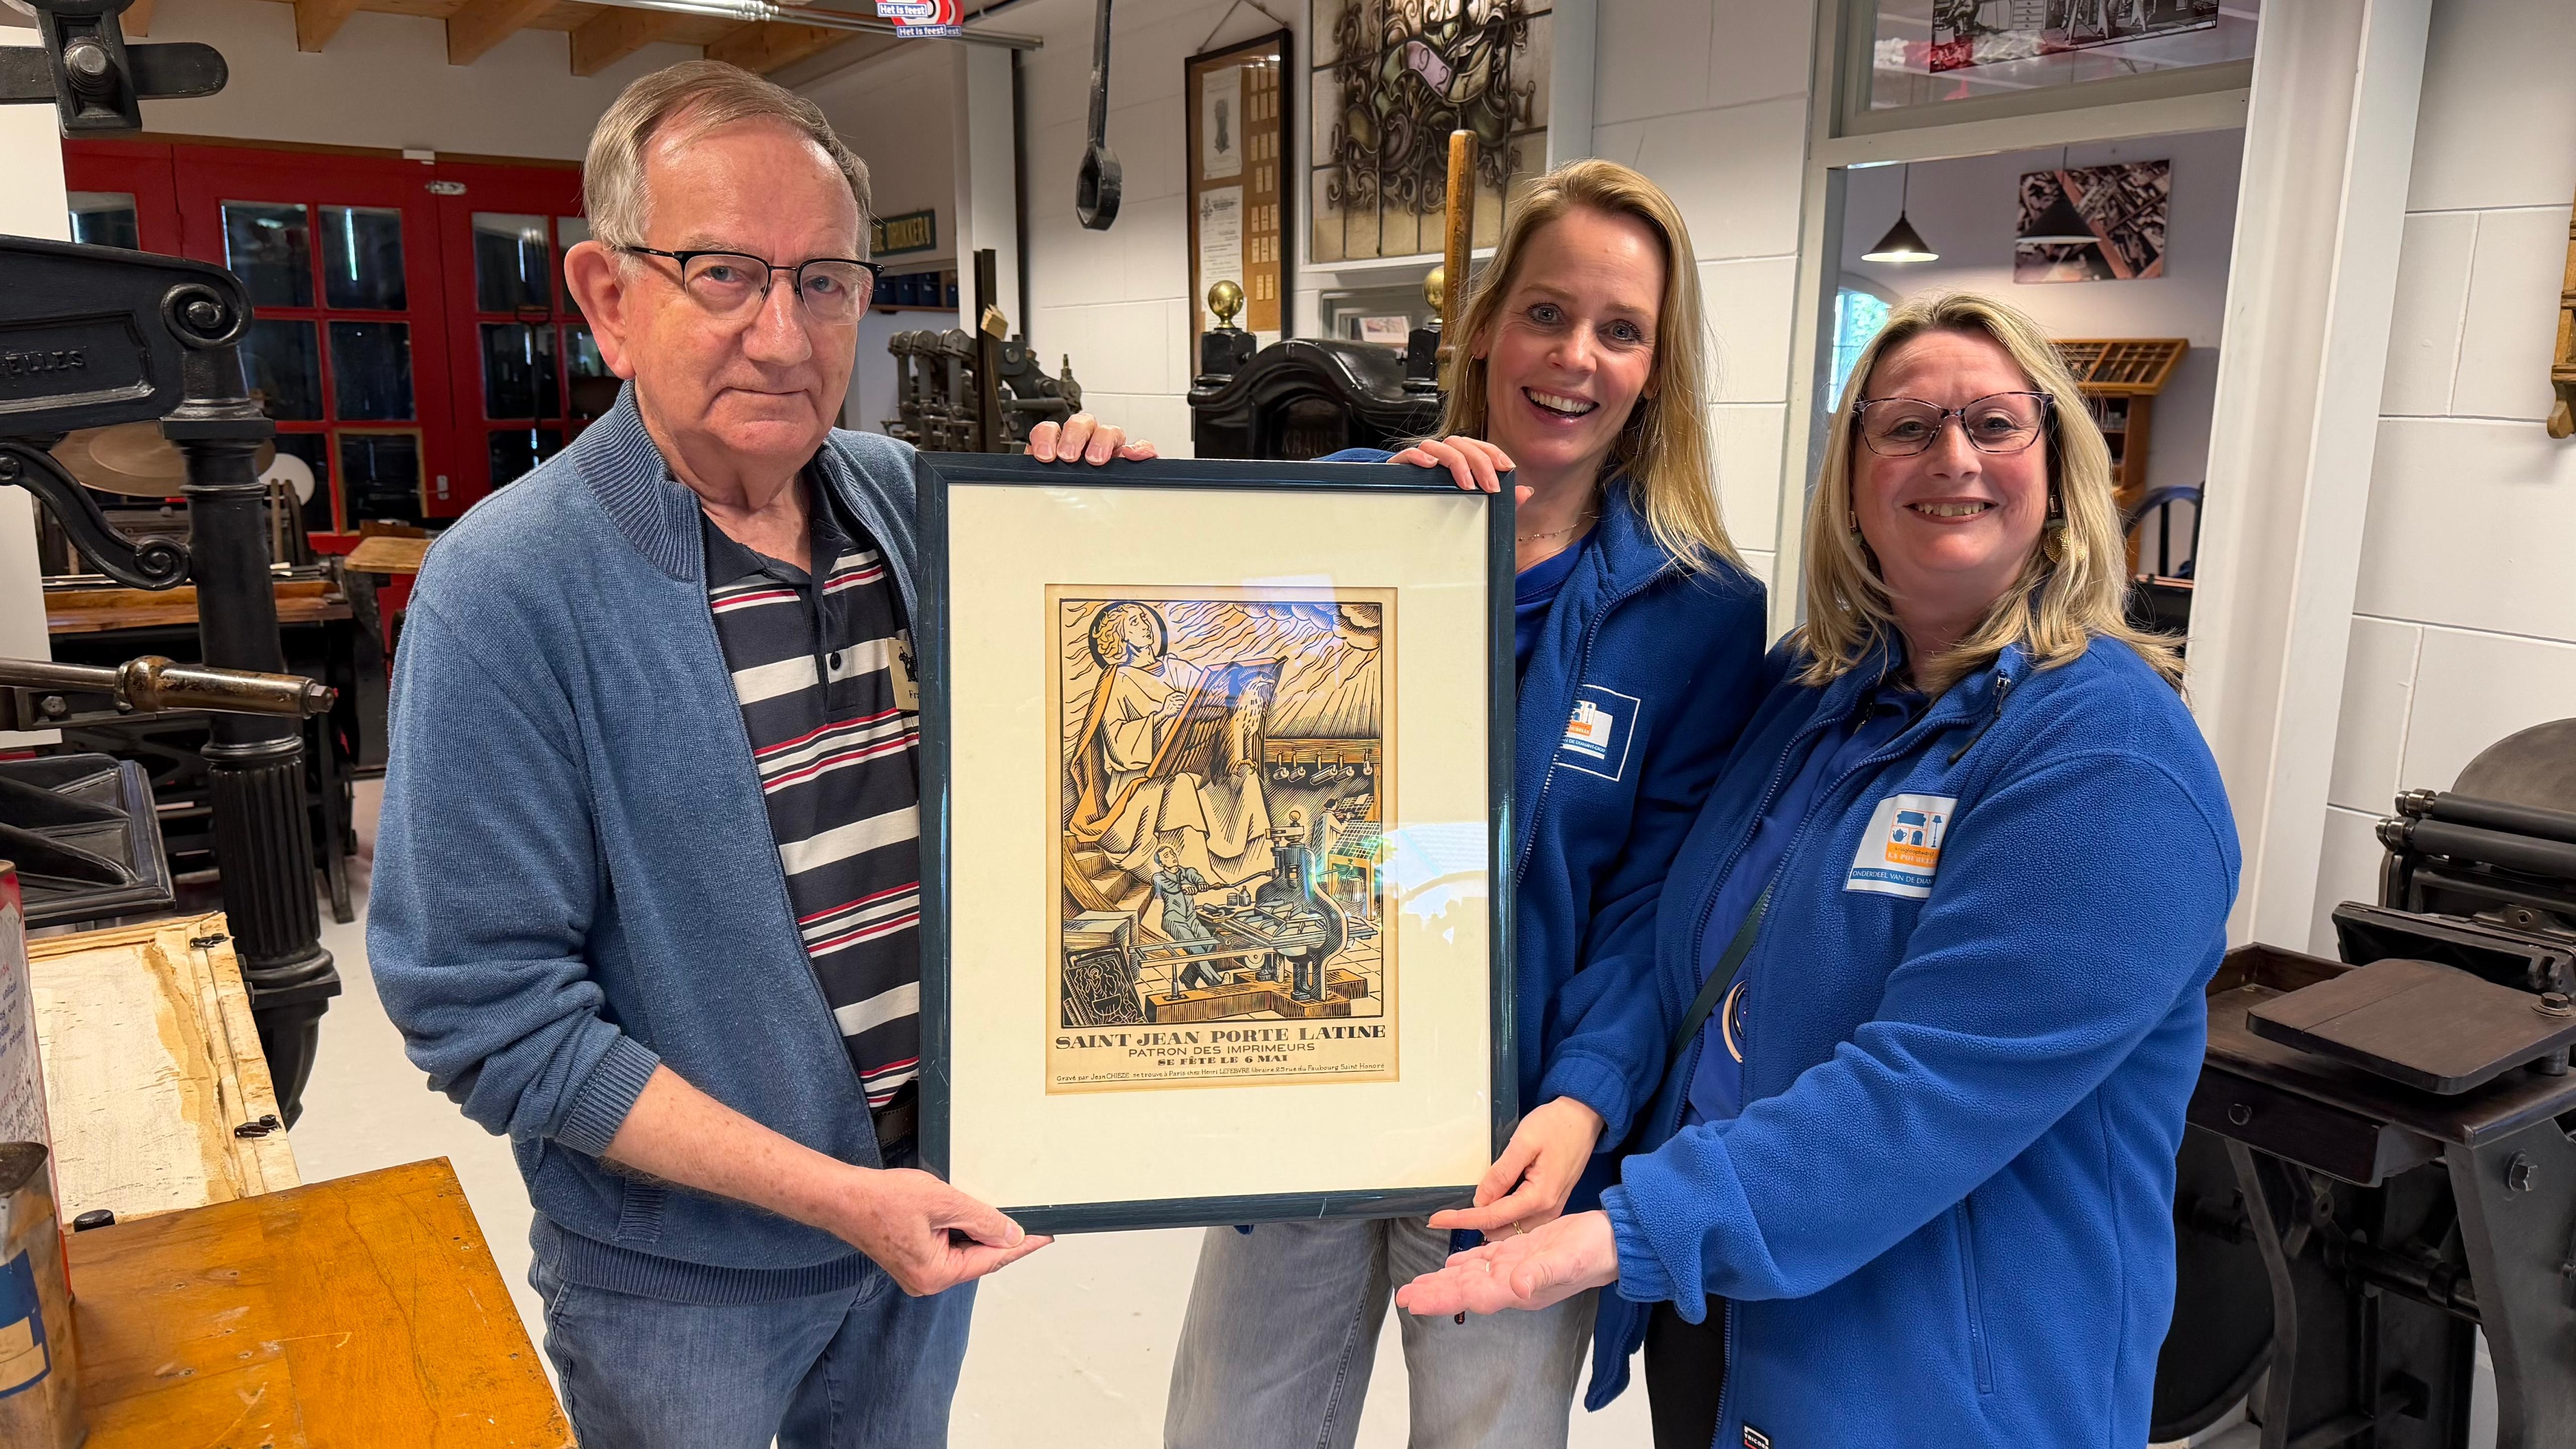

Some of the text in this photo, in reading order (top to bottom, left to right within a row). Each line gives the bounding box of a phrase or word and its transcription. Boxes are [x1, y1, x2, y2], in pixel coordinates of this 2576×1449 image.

[880, 5, 896, 14] Het
[905, 6, 926, 15] feest
[899, 28, 914, 36] Het
[924, 27, 944, 35] feest
[1, 350, 86, 375] ELLES
[1852, 870, 1888, 879] ONDERDEEL
[1890, 873, 1904, 881] VAN
[1906, 875, 1915, 883] DE
[1056, 1025, 1386, 1050] SAINT JEAN PORTE LATINE
[1129, 1043, 1315, 1058] PATRON DES IMPRIMEURS
[1157, 1058, 1175, 1066] SE
[1180, 1056, 1217, 1065] FÊTE
[1245, 1056, 1253, 1064] 6
[1257, 1055, 1288, 1063] MAI
